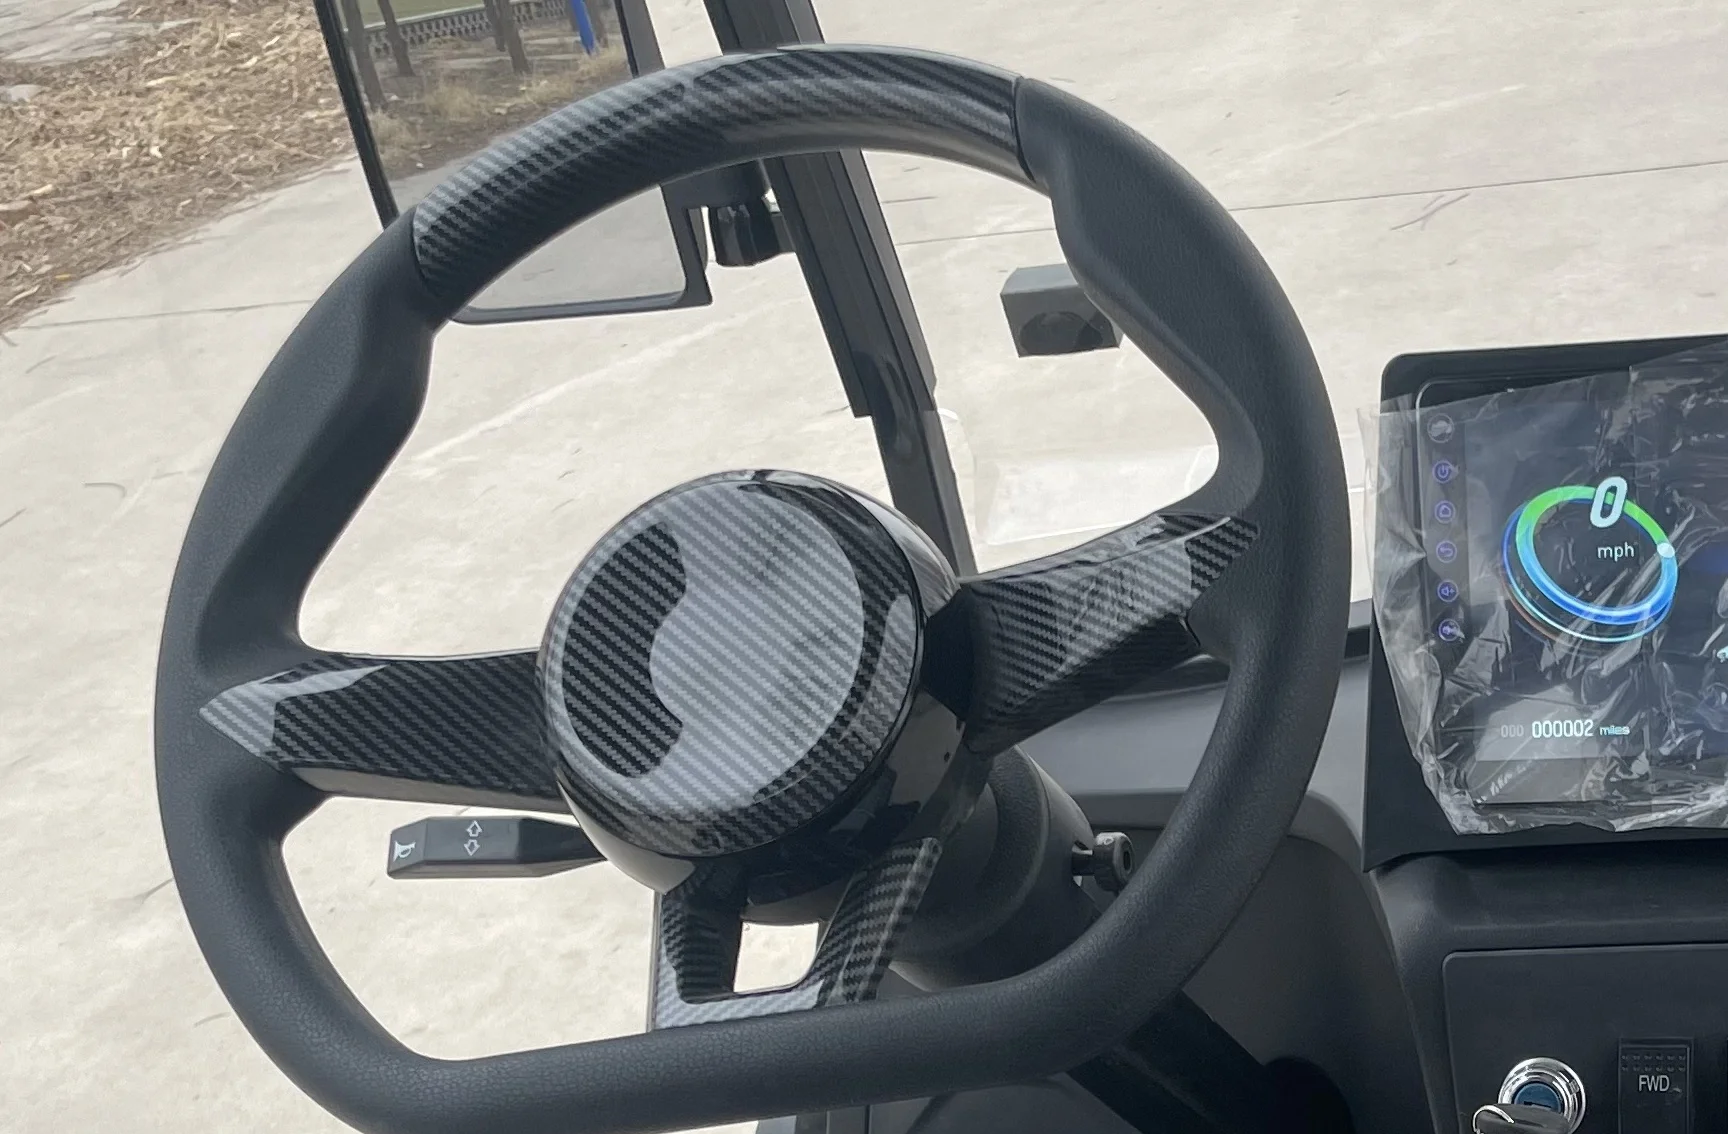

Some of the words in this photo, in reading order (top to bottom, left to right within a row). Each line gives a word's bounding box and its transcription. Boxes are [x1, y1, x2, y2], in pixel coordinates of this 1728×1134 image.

[1590, 476, 1628, 528] 0
[1597, 541, 1634, 562] mph
[1532, 719, 1594, 739] 000002
[1638, 1074, 1670, 1092] FWD
